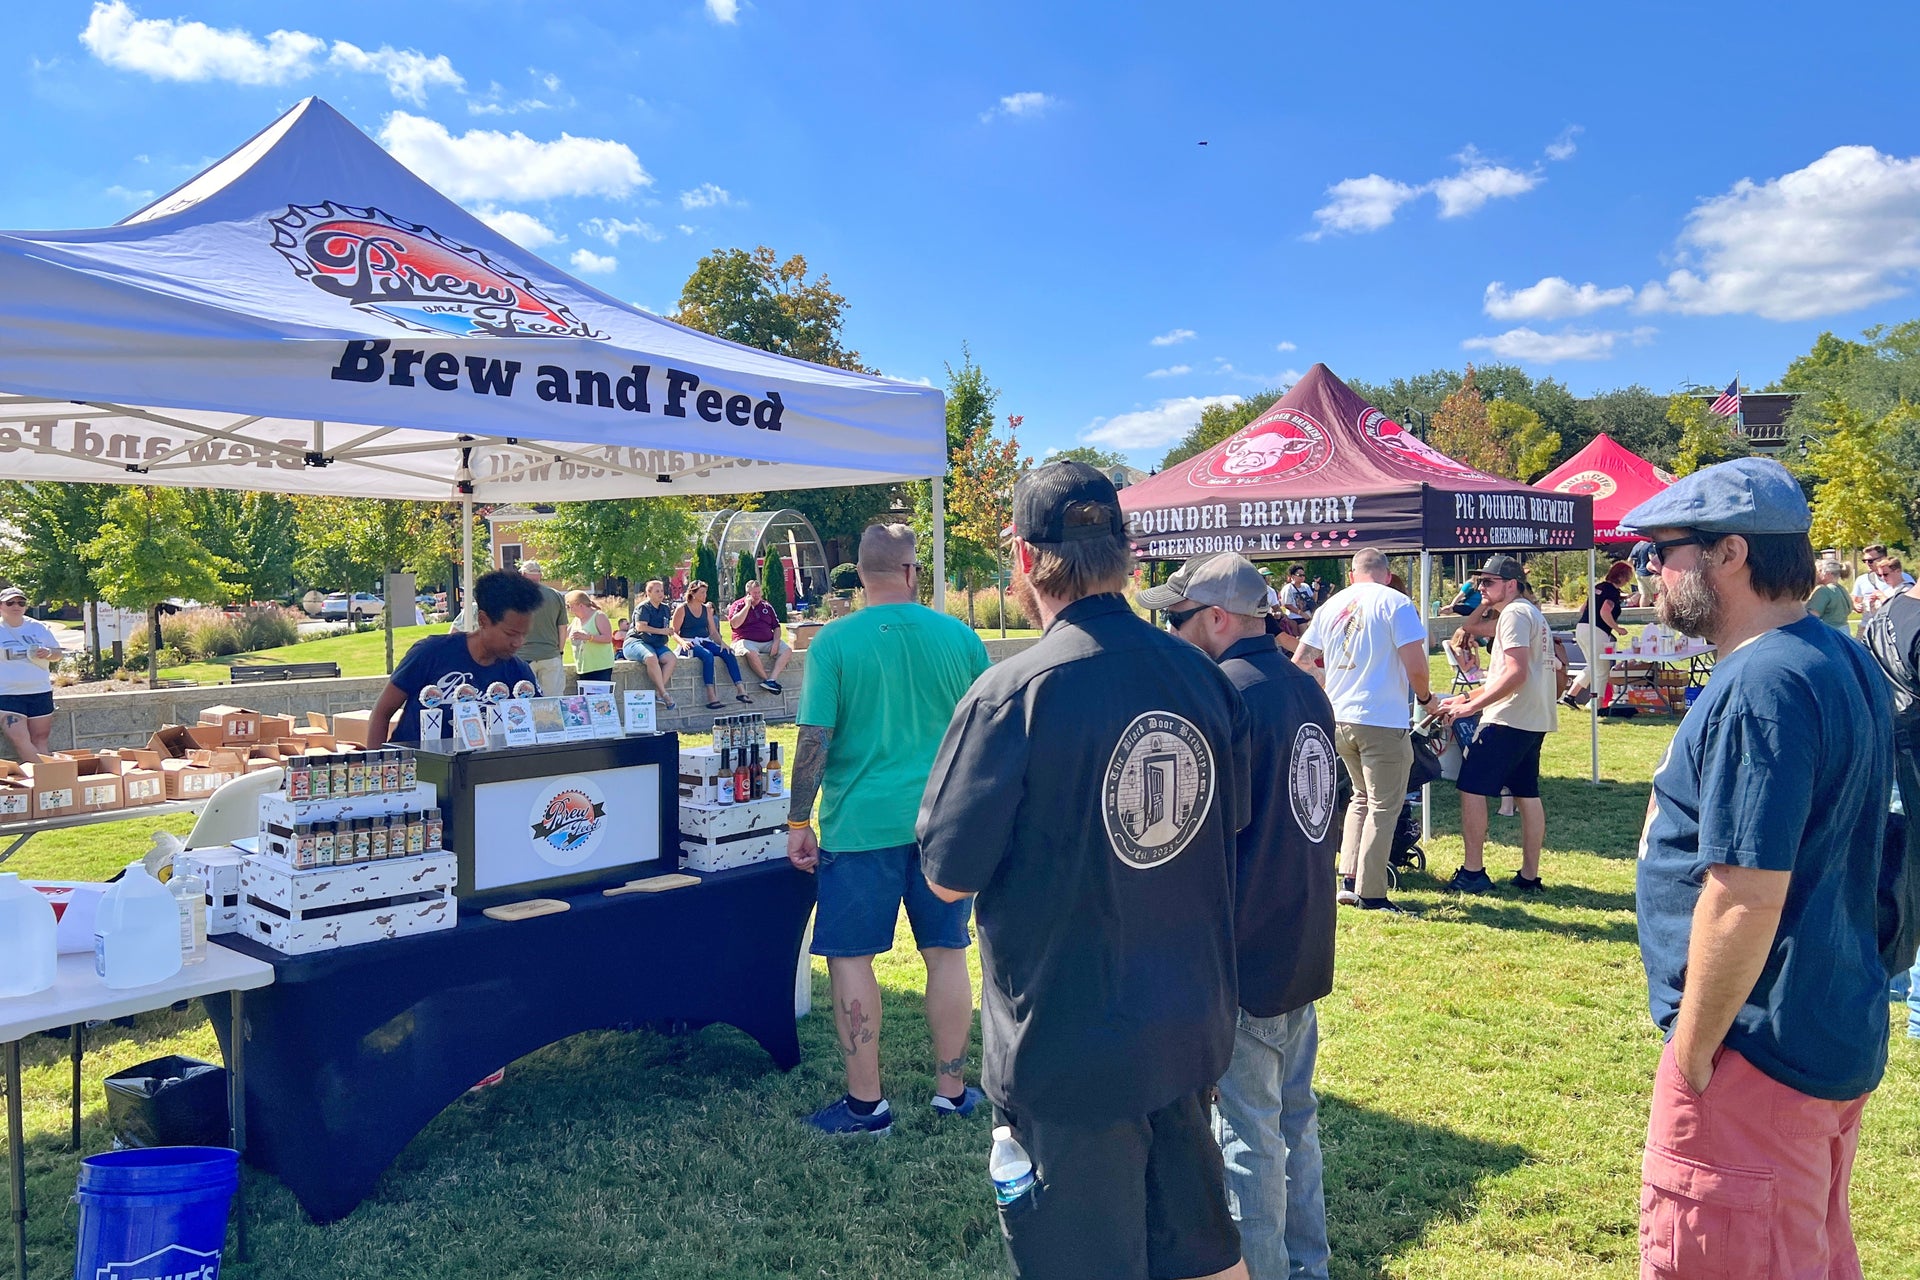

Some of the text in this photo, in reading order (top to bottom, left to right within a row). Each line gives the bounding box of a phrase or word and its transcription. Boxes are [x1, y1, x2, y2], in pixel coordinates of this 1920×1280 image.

[305, 231, 516, 305] Brew
[422, 304, 611, 338] and Feed
[331, 339, 785, 431] Brew and Feed
[1291, 415, 1324, 441] BREWERY
[1129, 496, 1357, 535] POUNDER BREWERY
[1455, 493, 1575, 524] PIG POUNDER BREWERY
[1149, 533, 1281, 557] GREENSBORO NC
[1489, 526, 1549, 545] GREENSBORO NC
[1147, 717, 1174, 730] Door
[1178, 723, 1207, 768] Brewery
[545, 798, 590, 830] Brew
[571, 819, 602, 835] Feed
